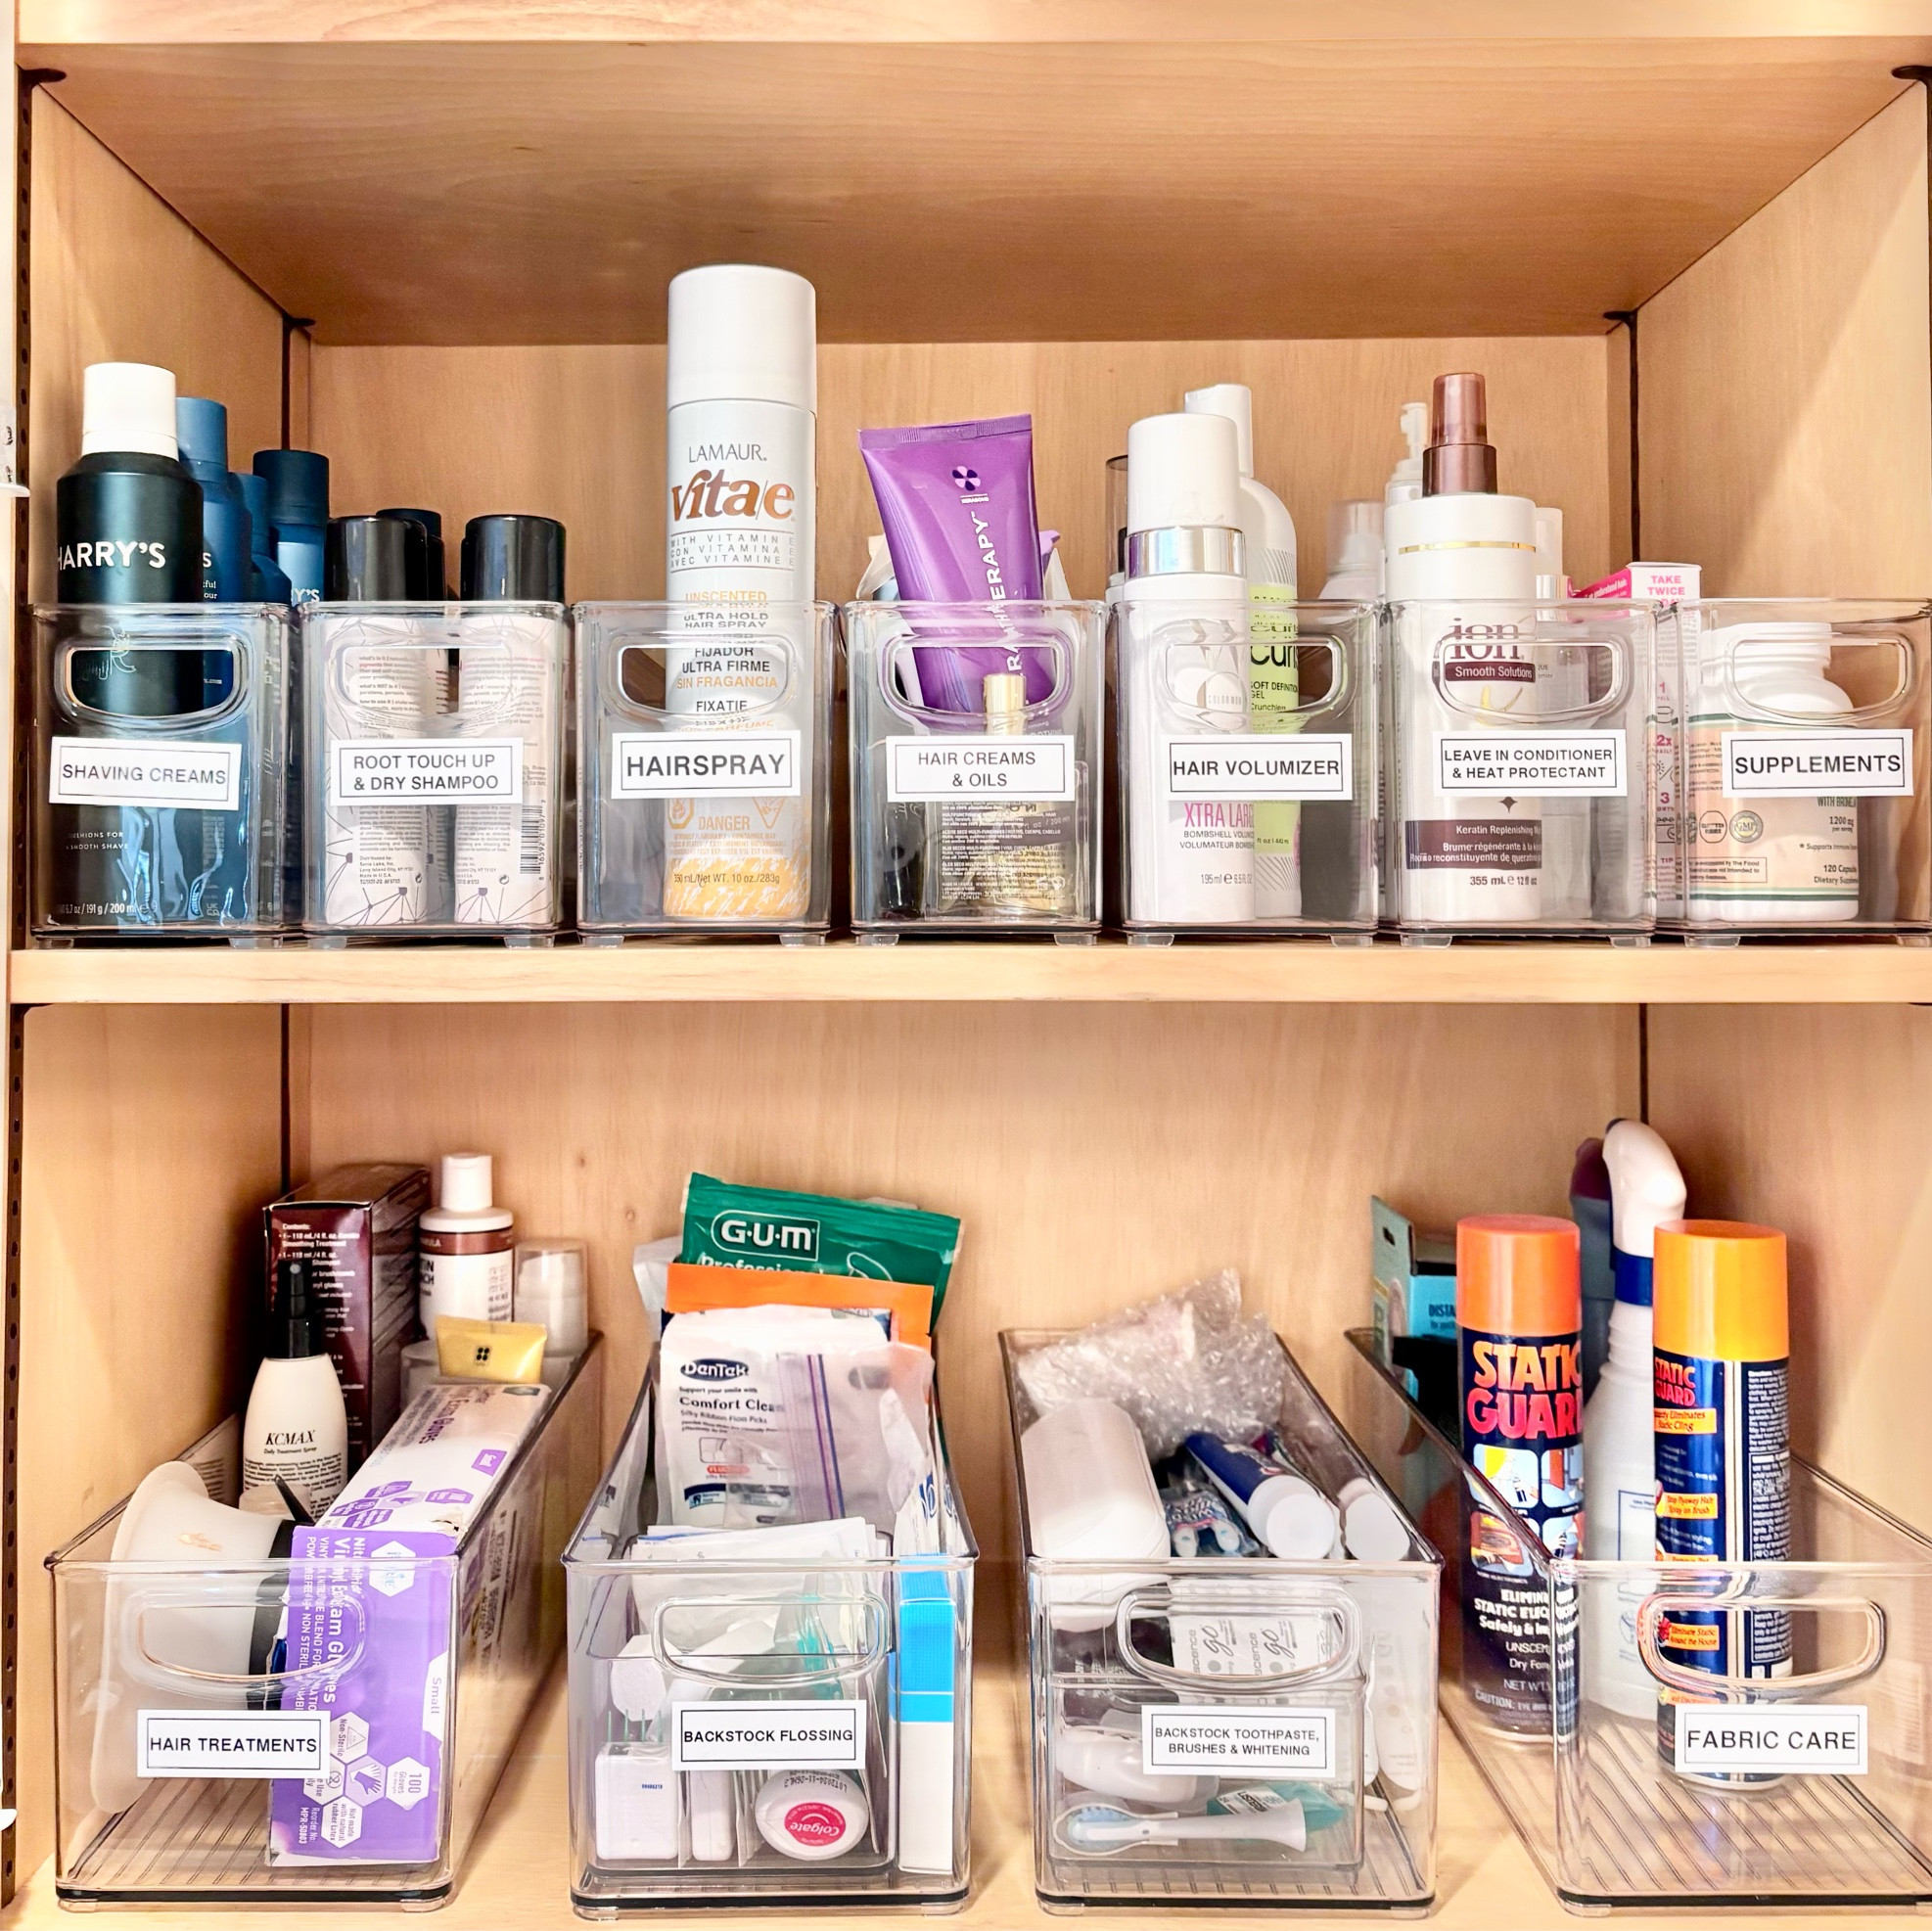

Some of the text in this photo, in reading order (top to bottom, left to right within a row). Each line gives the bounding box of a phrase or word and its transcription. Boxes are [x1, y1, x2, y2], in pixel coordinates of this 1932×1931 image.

[670, 533, 795, 548] WITH VITAMIN E
[670, 544, 795, 559] CON VITAMINA E
[669, 554, 795, 568] AVEC VITAMINE E
[1651, 575, 1681, 584] TAKE
[1647, 587, 1686, 596] TWICE
[684, 612, 724, 621] ULTRA
[695, 646, 754, 658] FIJADOR
[682, 661, 770, 673] ULTRA FIRME
[1455, 666, 1495, 677] Smooth
[1497, 666, 1533, 679] Solutions
[677, 676, 779, 689] SIN FRAGANCIA
[1659, 681, 1666, 693] 1
[1657, 735, 1673, 747] 2x
[353, 754, 495, 769] ROOT TOUCH UP
[918, 751, 1036, 765] HAIR CREAMS
[1445, 749, 1613, 761] LEAVE IN CONDITIONER
[627, 754, 785, 777] HAIRSPRAY
[1173, 759, 1340, 775] HAIR VOLUMIZER
[1452, 766, 1606, 779] & HEAT PROTECTANT
[1734, 755, 1902, 775] SUPPLEMENTS
[62, 764, 226, 784] SHAVING CREAMS
[951, 773, 1008, 787] & OILS
[353, 775, 499, 791] & DRY SHAMPOO
[1660, 792, 1670, 804] 3
[1817, 796, 1835, 807] WITH
[698, 815, 751, 831] DANGER
[1184, 803, 1226, 828] XTRA
[1183, 830, 1232, 839] BOMBSHELL
[1456, 825, 1488, 835] Keratin
[1433, 852, 1510, 863] reconstituyente de
[1823, 864, 1837, 873] 120
[733, 873, 742, 883] 10
[1469, 876, 1488, 886] 355
[1491, 876, 1505, 886] mL
[1814, 876, 1838, 885] Dietary
[86, 903, 96, 914] 191
[110, 903, 125, 914] 200
[685, 1361, 747, 1378] DenTek
[1473, 1340, 1582, 1391] STATIC
[1655, 1356, 1696, 1389] STATIC
[1655, 1379, 1696, 1407] GUARD
[679, 1397, 741, 1410] Comfort
[265, 1430, 315, 1446] KCMAX
[1473, 1597, 1518, 1618] STATIC
[302, 1612, 311, 1633] NON
[1479, 1615, 1523, 1637] Safely
[313, 1614, 326, 1647] BLEND
[1509, 1657, 1528, 1672] Dry
[431, 1677, 442, 1715] Small
[684, 1728, 854, 1743] BACKSTOCK FLOSSING
[1156, 1727, 1319, 1742] BACKSTOCK TOOTHPASTE,
[1687, 1729, 1856, 1750] FABRIC CARE
[150, 1737, 318, 1753] HAIR TREATMENTS
[1169, 1743, 1310, 1756] BRUSHES & WHITENING
[397, 1770, 407, 1795] Gloves
[407, 1772, 423, 1795] 100
[338, 1817, 346, 1842] natural
[347, 1817, 356, 1838] made
[790, 1821, 840, 1837] Colgate
